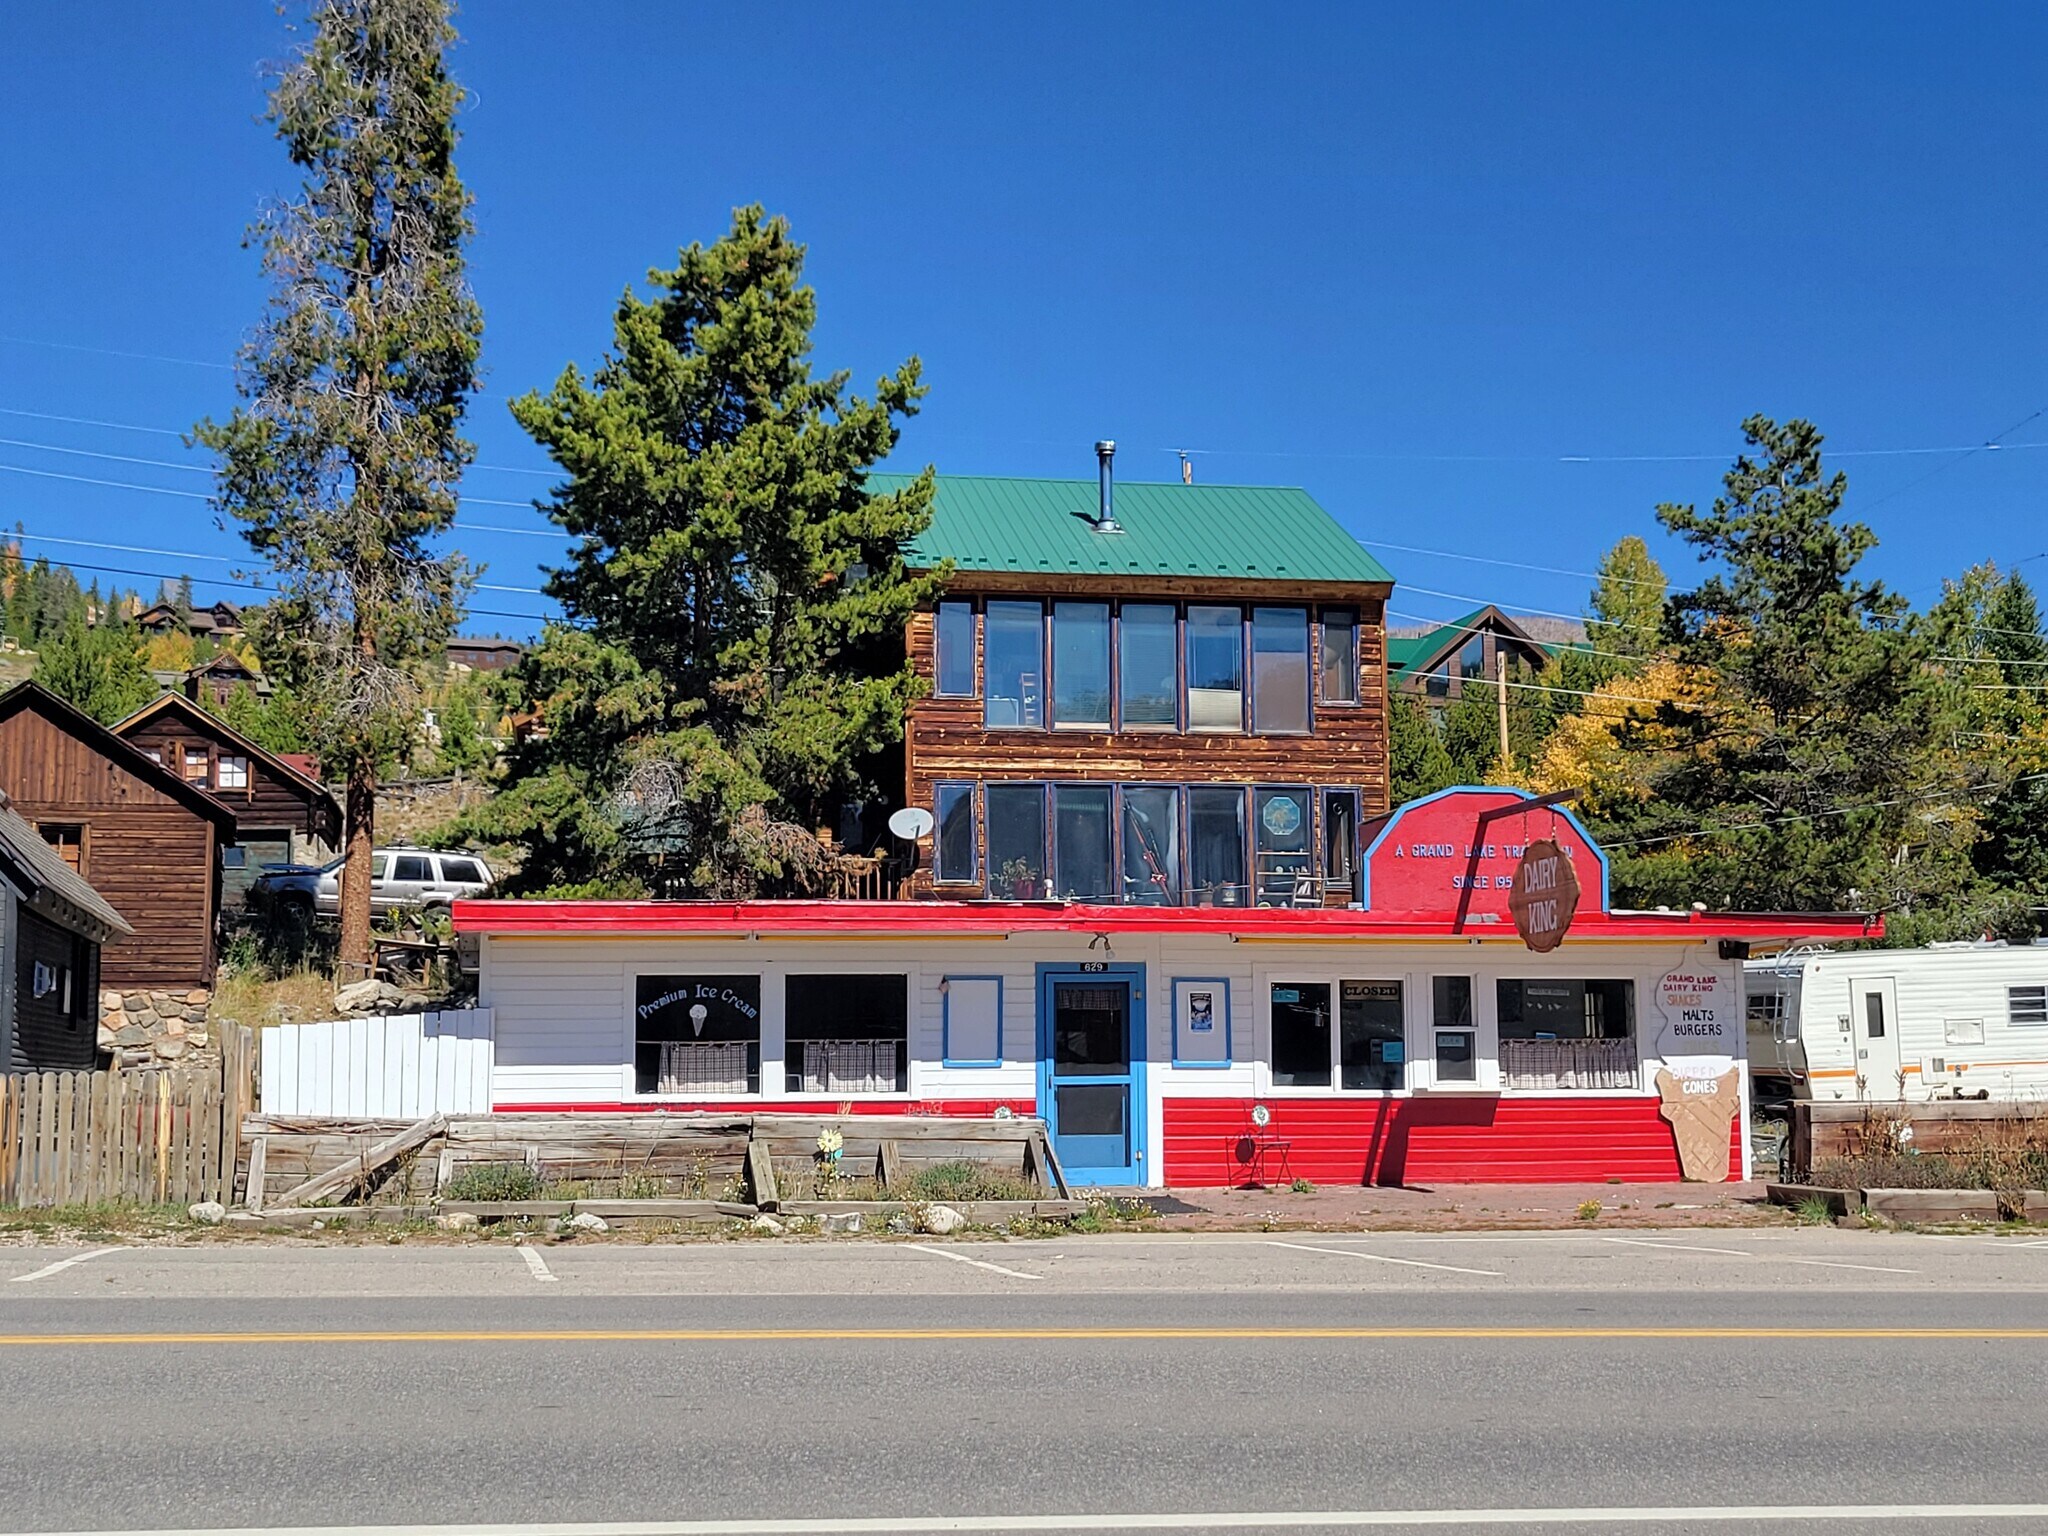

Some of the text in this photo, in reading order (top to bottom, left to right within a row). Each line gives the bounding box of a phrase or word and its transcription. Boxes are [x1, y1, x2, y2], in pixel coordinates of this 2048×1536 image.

[1395, 844, 1404, 857] A
[1411, 844, 1454, 857] GRAND
[1464, 844, 1496, 858] LAKE
[1523, 856, 1558, 893] DAIRY
[1452, 875, 1513, 888] SINCE 195
[1528, 899, 1557, 934] KING
[1084, 963, 1103, 972] 629
[1666, 975, 1717, 984] GRAND LAKE
[1344, 986, 1398, 996] CLOSED
[1663, 984, 1688, 992] DAIRY
[638, 984, 758, 1019] Premium Ice Cream
[1666, 994, 1702, 1007] SHAKES
[1682, 1010, 1715, 1021] MALTS
[1674, 1024, 1723, 1036] BURGERS
[1682, 1080, 1718, 1094] CONES
